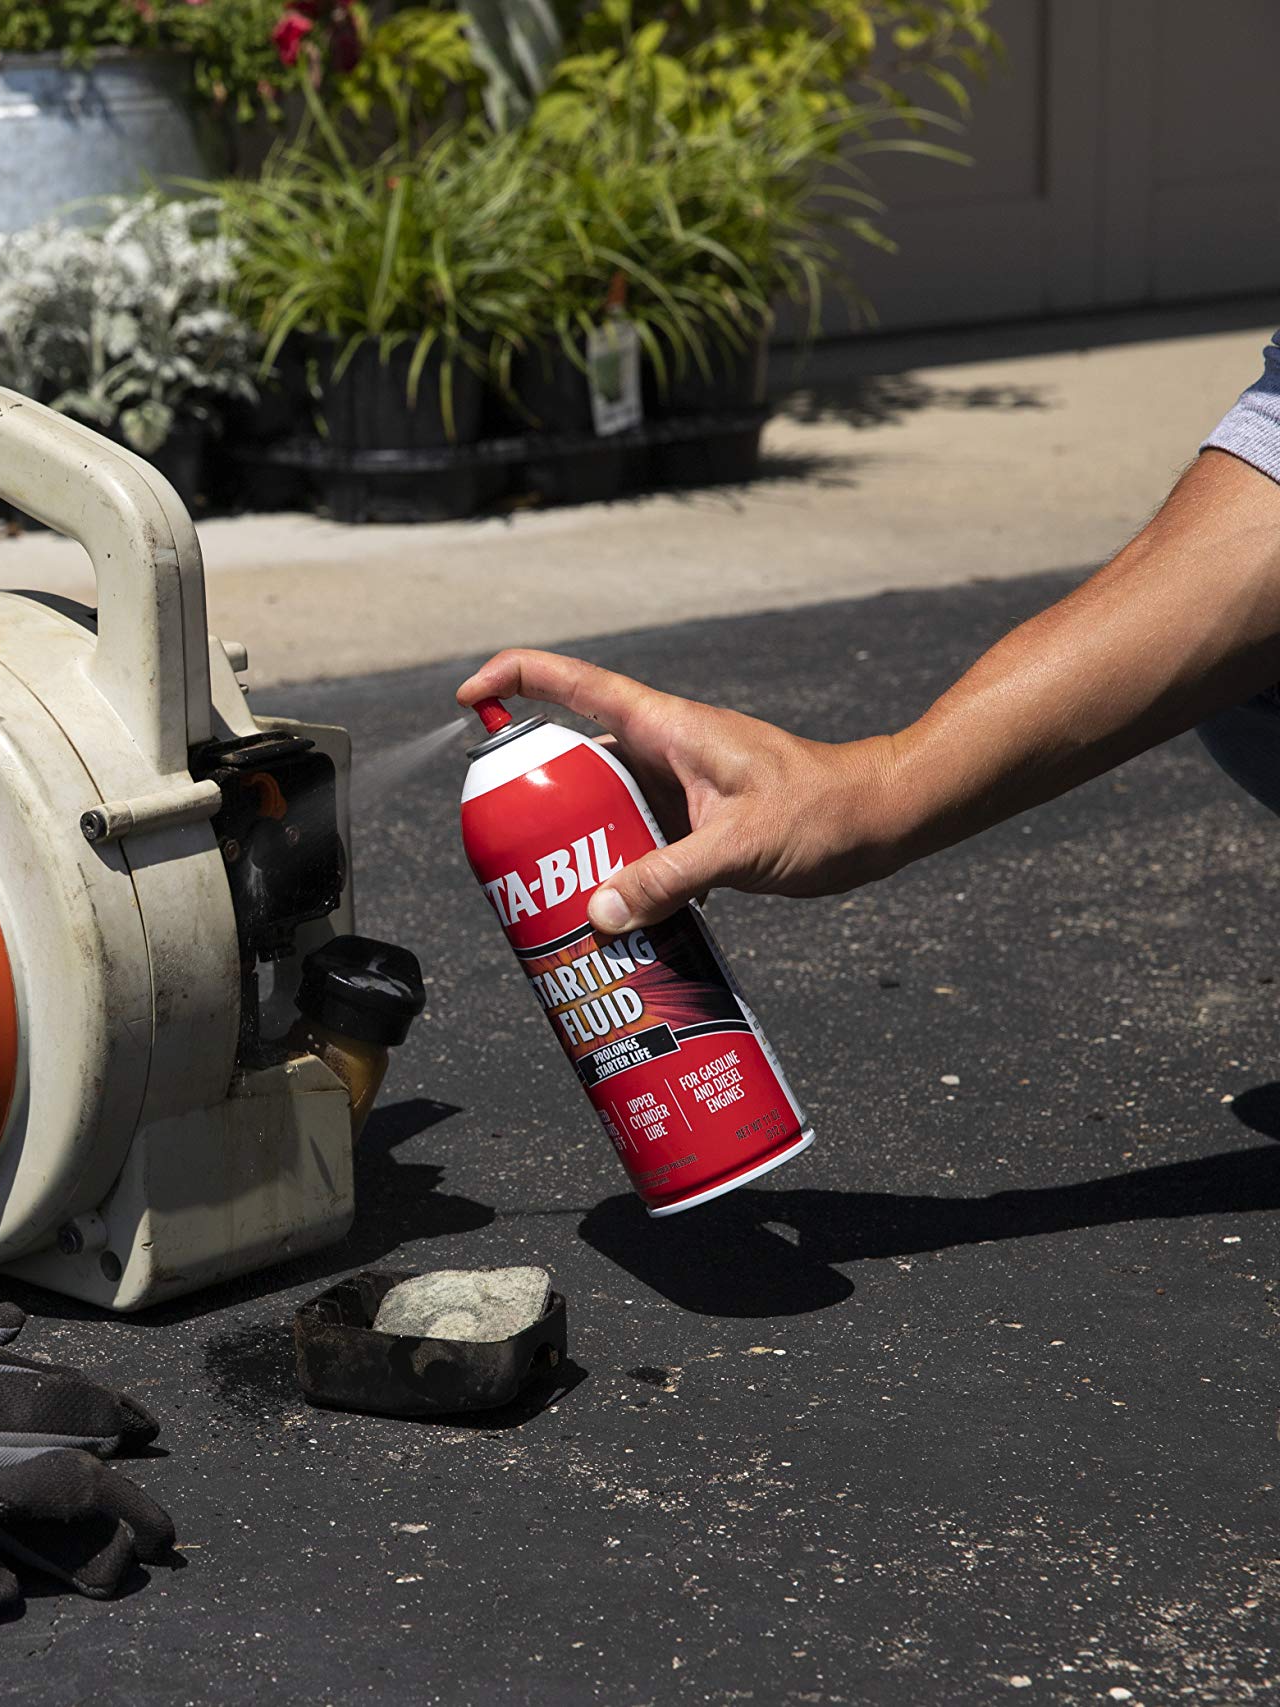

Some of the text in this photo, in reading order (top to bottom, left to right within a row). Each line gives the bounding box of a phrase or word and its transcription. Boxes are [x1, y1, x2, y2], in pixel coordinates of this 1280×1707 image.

[484, 826, 624, 927] TA-BIL
[558, 986, 643, 1046] FLUID
[592, 1037, 640, 1065] PROLONGS
[595, 1047, 653, 1080] STARTER LIFE
[679, 1074, 701, 1092] FOR
[699, 1050, 741, 1080] GASOLINE
[693, 1068, 744, 1103] AND DIESEL
[626, 1092, 657, 1113] UPPER
[705, 1083, 746, 1114] ENGINES
[629, 1104, 671, 1130] CYLINDER
[644, 1122, 669, 1142] LUBE
[735, 1125, 751, 1141] NET
[749, 1118, 763, 1132] WT
[762, 1113, 772, 1127] 11
